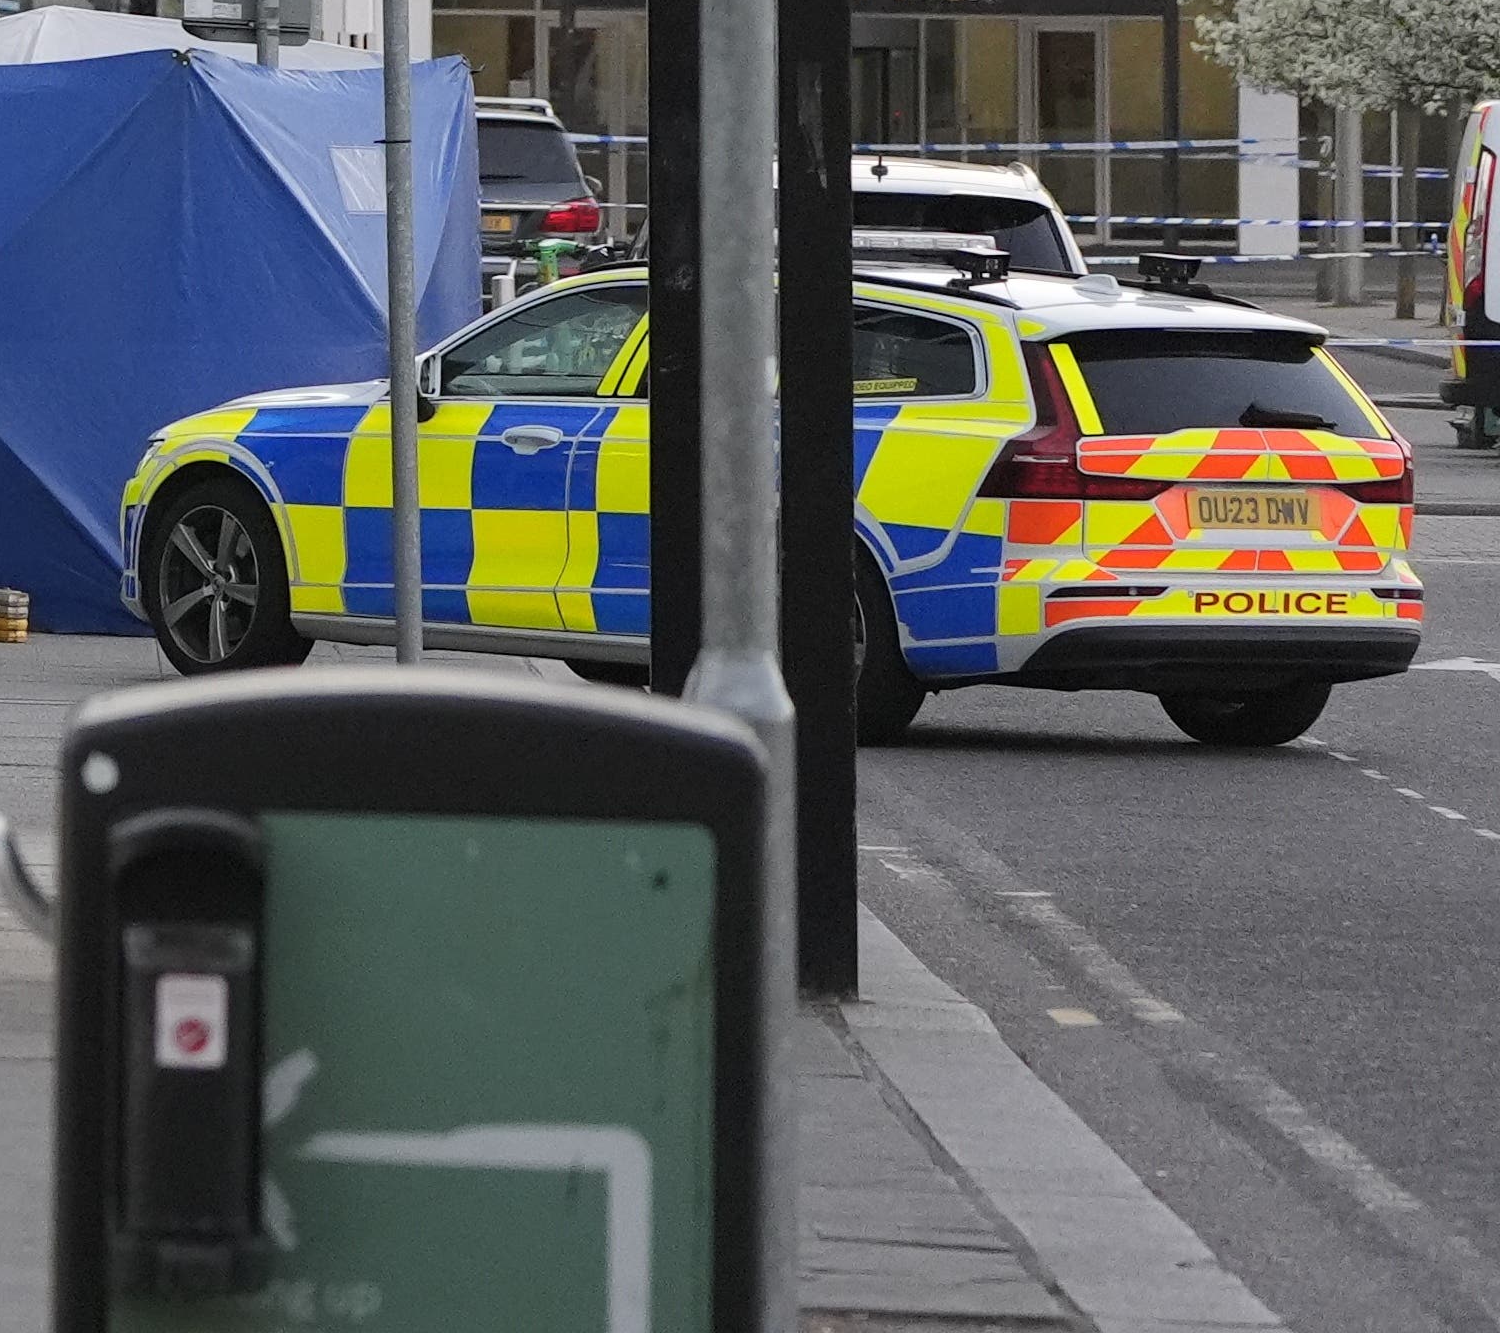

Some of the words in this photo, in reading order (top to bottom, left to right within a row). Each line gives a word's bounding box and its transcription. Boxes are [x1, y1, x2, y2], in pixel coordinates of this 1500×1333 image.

[874, 379, 915, 390] EQUIPPED
[1198, 496, 1260, 524] OU23
[1194, 592, 1349, 615] POLICE
